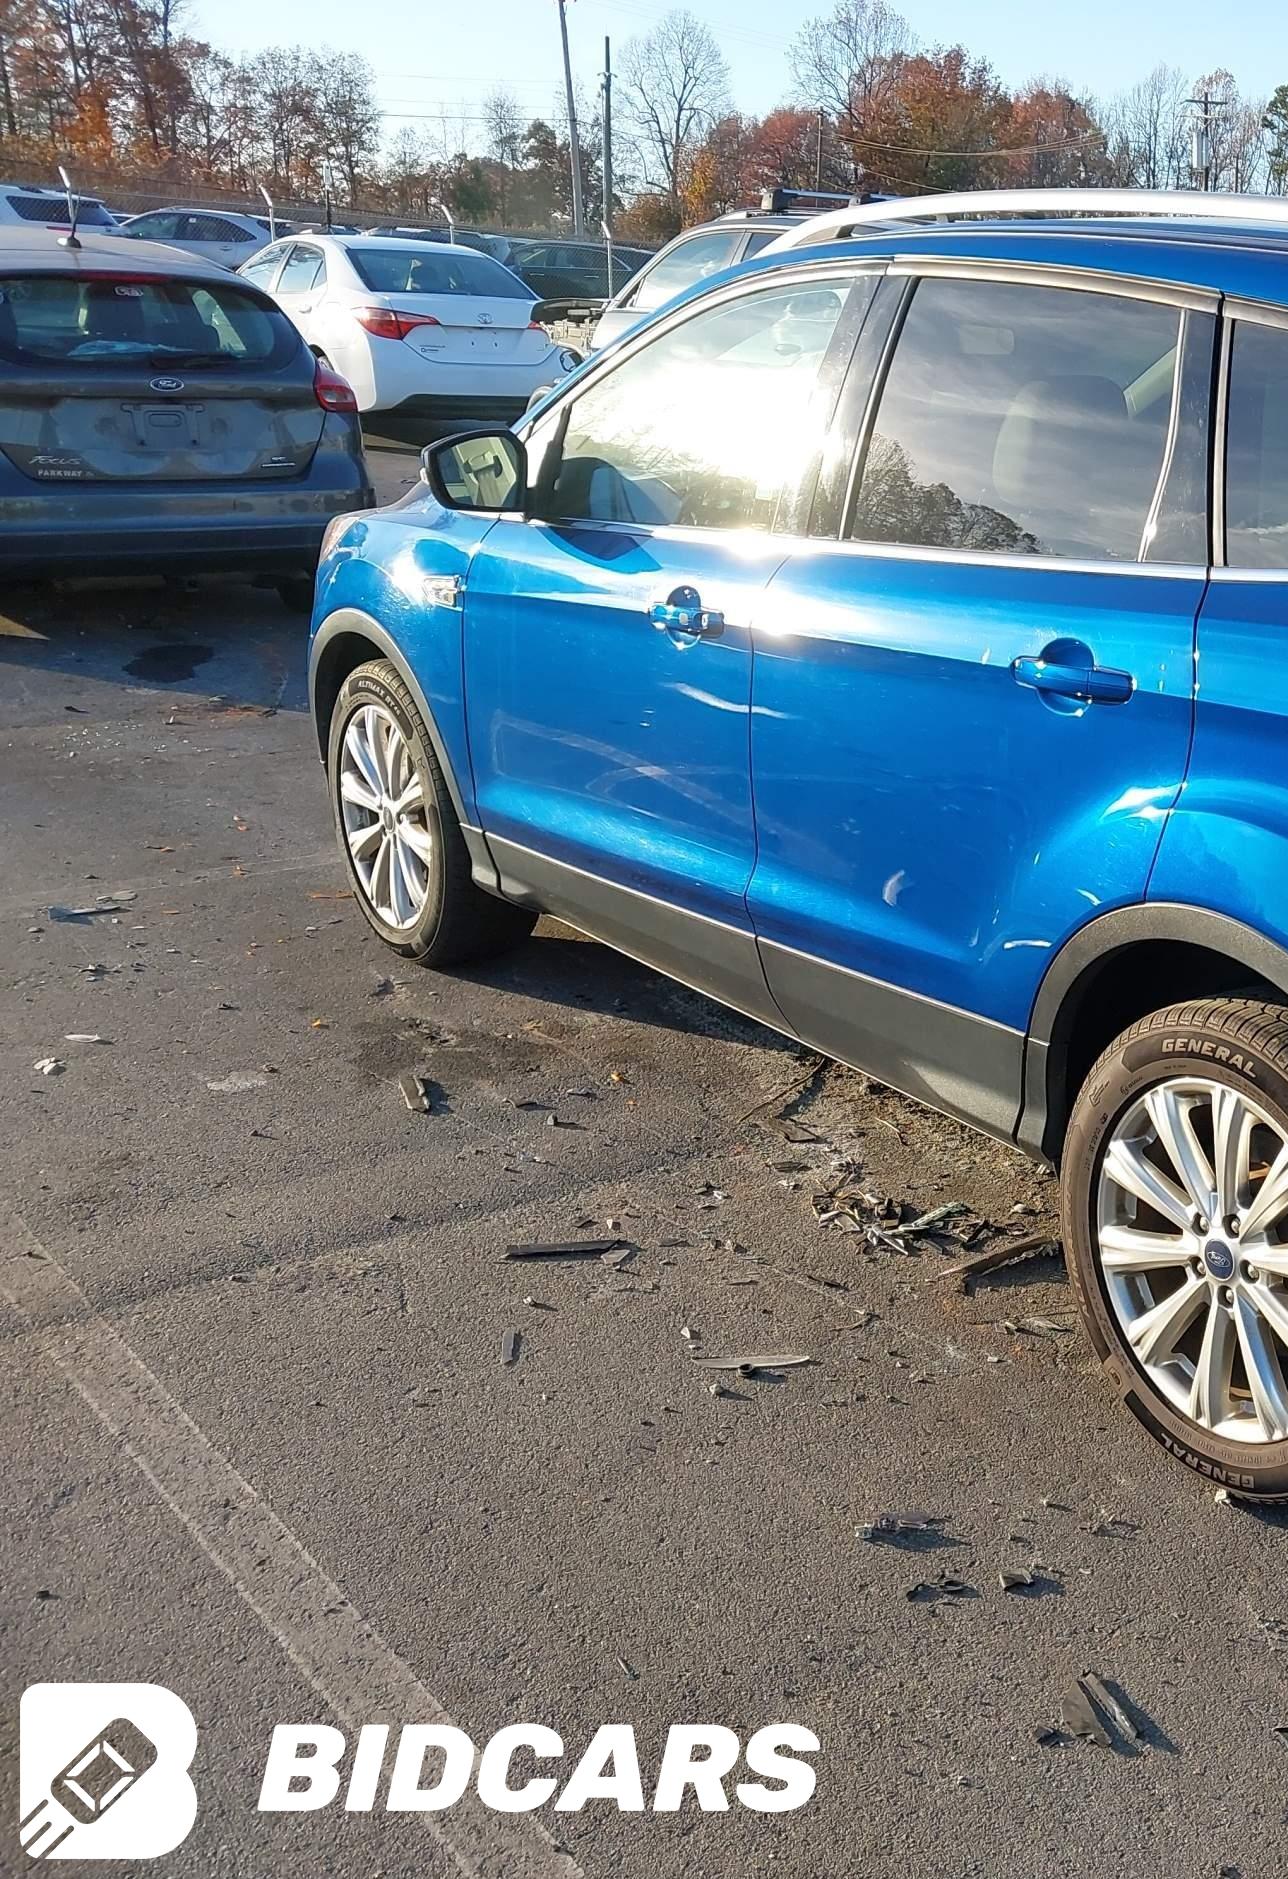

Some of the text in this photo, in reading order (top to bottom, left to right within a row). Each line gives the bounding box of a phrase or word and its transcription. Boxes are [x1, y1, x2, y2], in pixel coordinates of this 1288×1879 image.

[37, 469, 82, 477] PARKWAY
[1161, 1037, 1258, 1079] GENERAL
[1160, 1432, 1256, 1489] GENERAL
